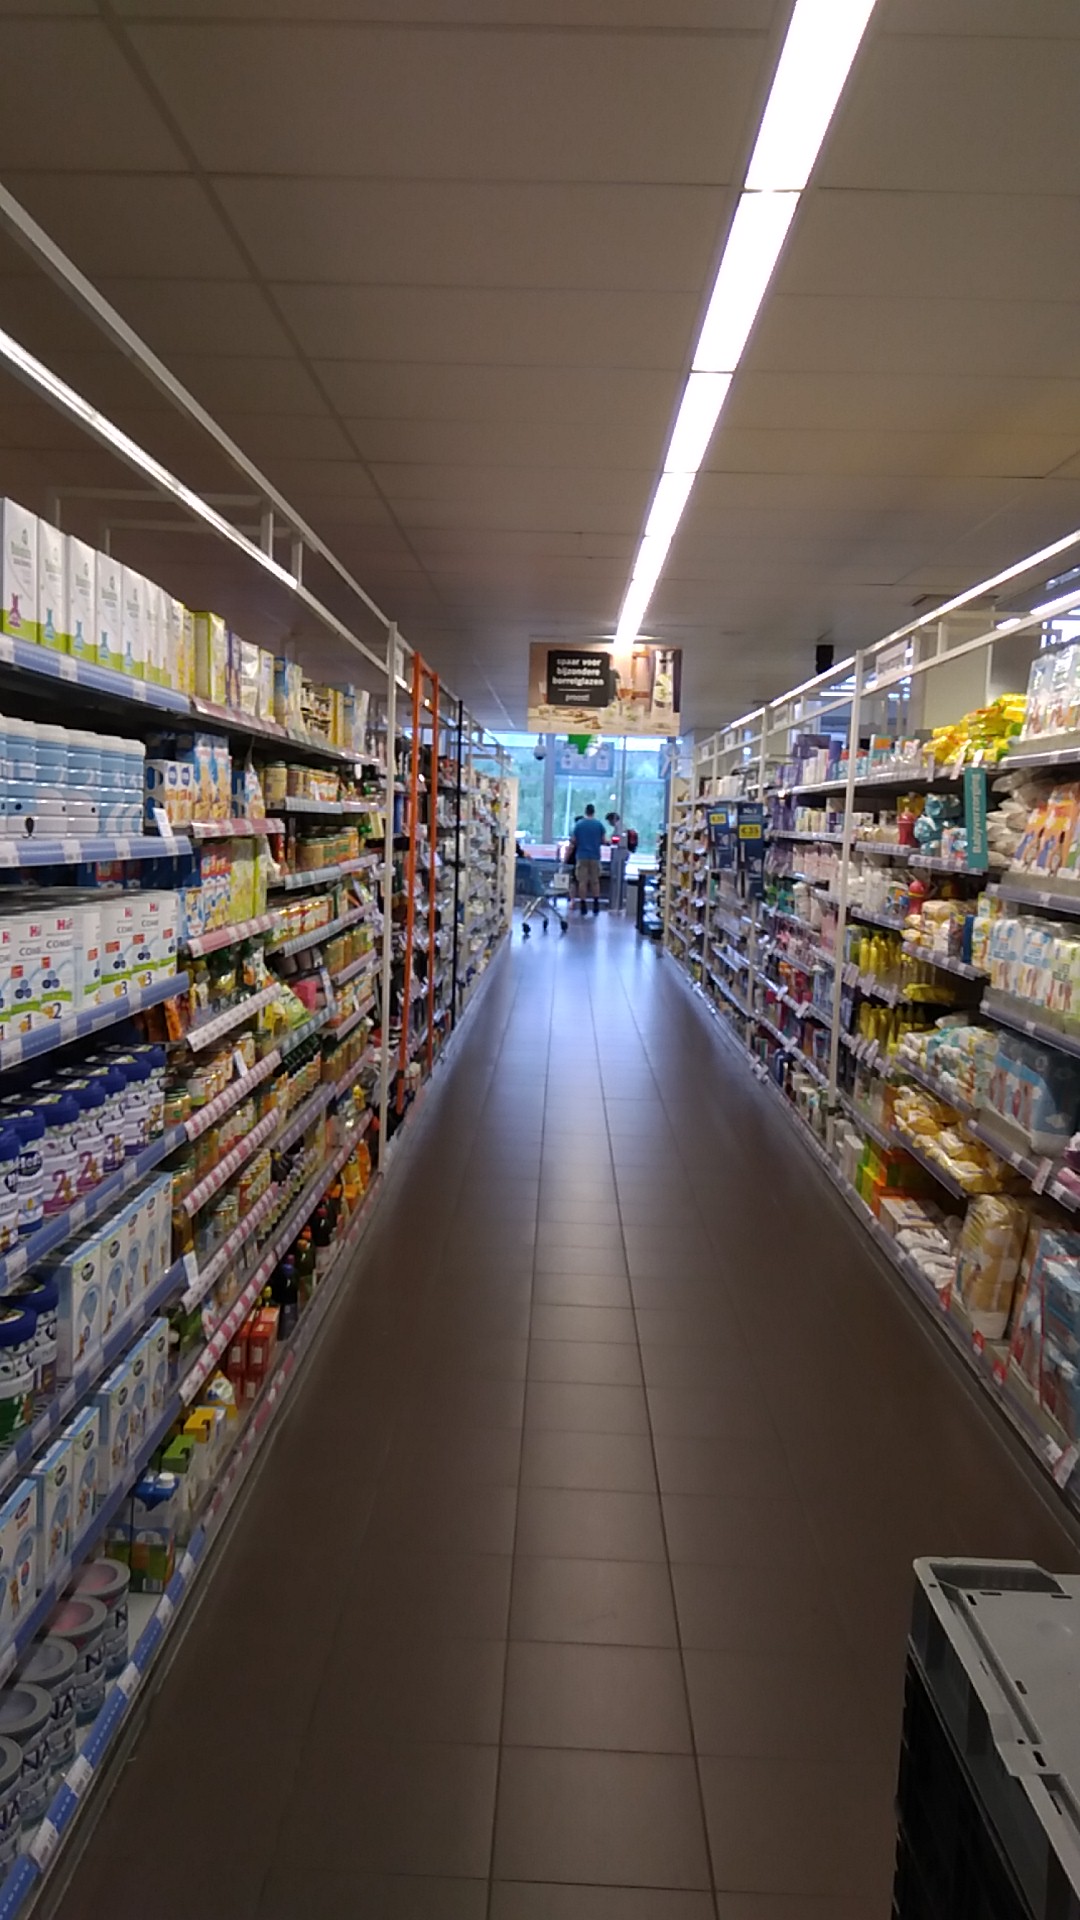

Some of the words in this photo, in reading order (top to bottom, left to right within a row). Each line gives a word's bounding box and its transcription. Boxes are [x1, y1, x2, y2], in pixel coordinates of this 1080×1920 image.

[582, 658, 602, 666] voor
[556, 667, 600, 676] bijzondere
[552, 676, 604, 686] borrelglazen
[145, 972, 153, 985] 3
[121, 981, 128, 995] 3
[52, 1002, 63, 1019] 2
